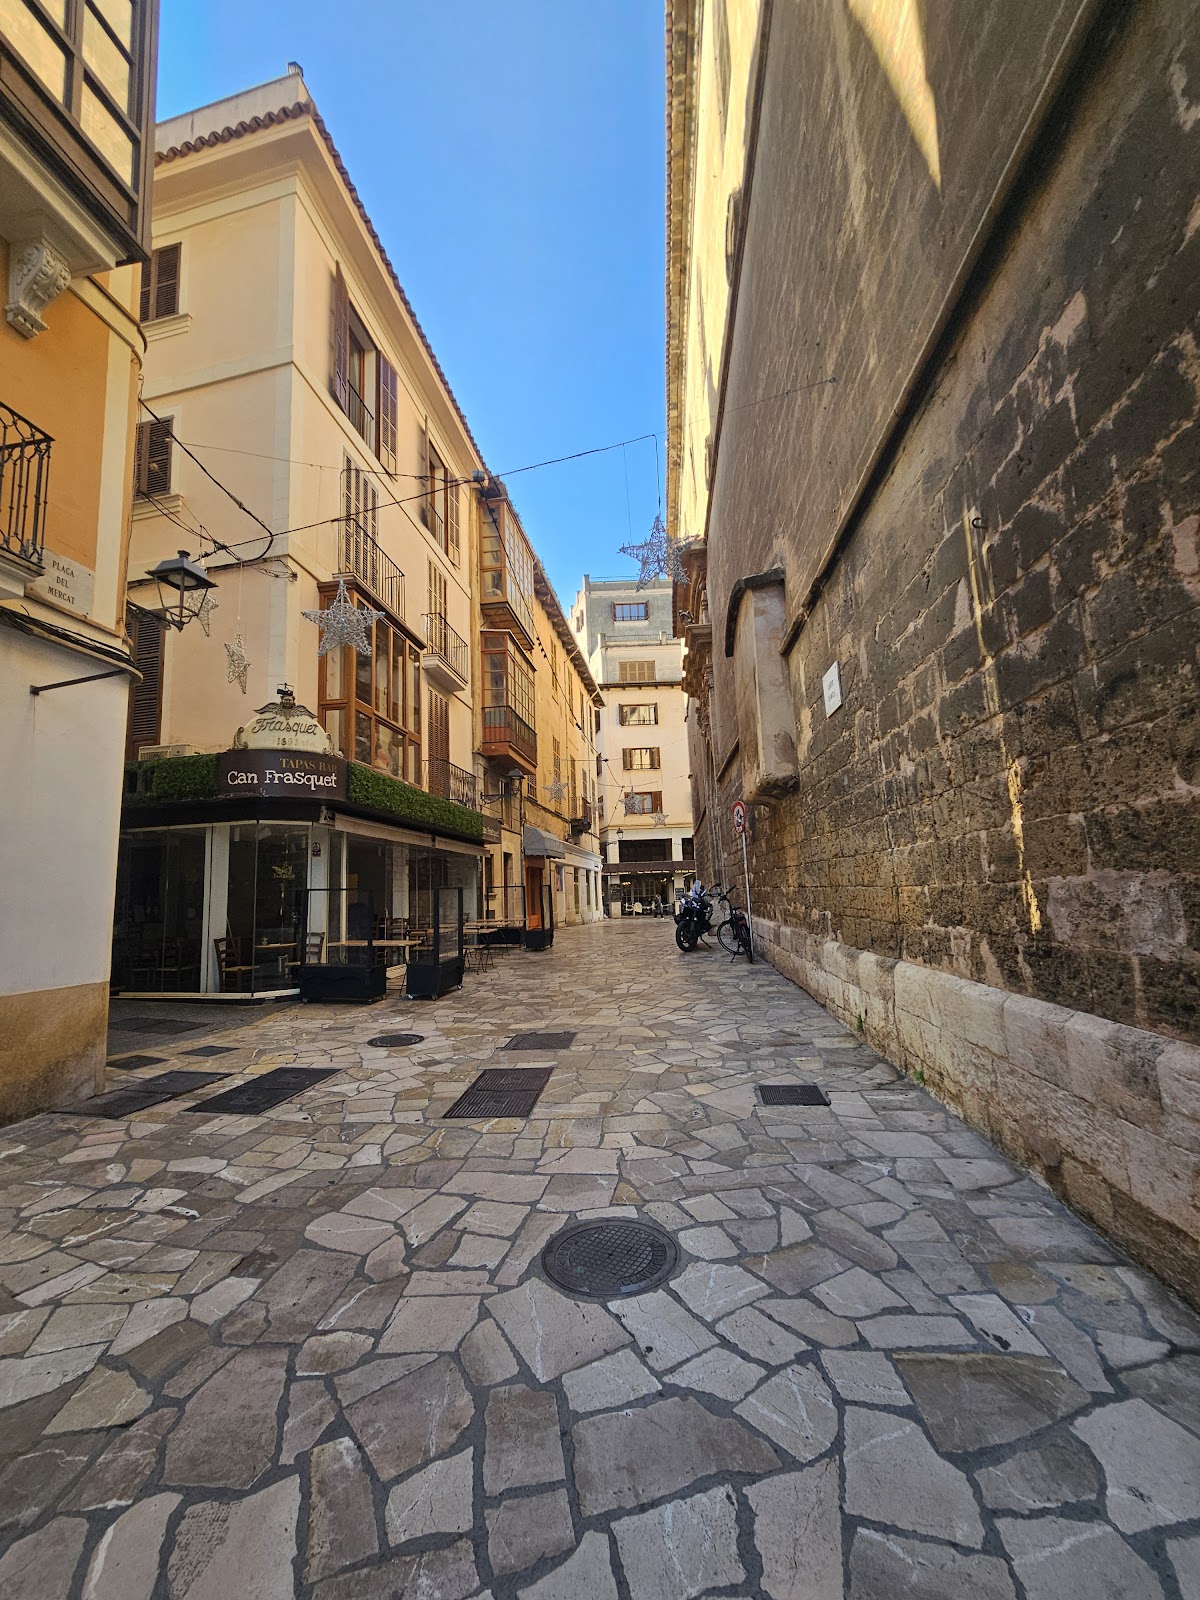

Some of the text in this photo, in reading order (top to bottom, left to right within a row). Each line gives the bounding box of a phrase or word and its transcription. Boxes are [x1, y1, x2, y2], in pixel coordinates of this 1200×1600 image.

[56, 575, 69, 589] DEL
[47, 586, 75, 605] MERCAT
[252, 716, 318, 737] Frasquet
[279, 757, 338, 774] TAPAS BAR
[227, 769, 338, 791] Can Frasquet
